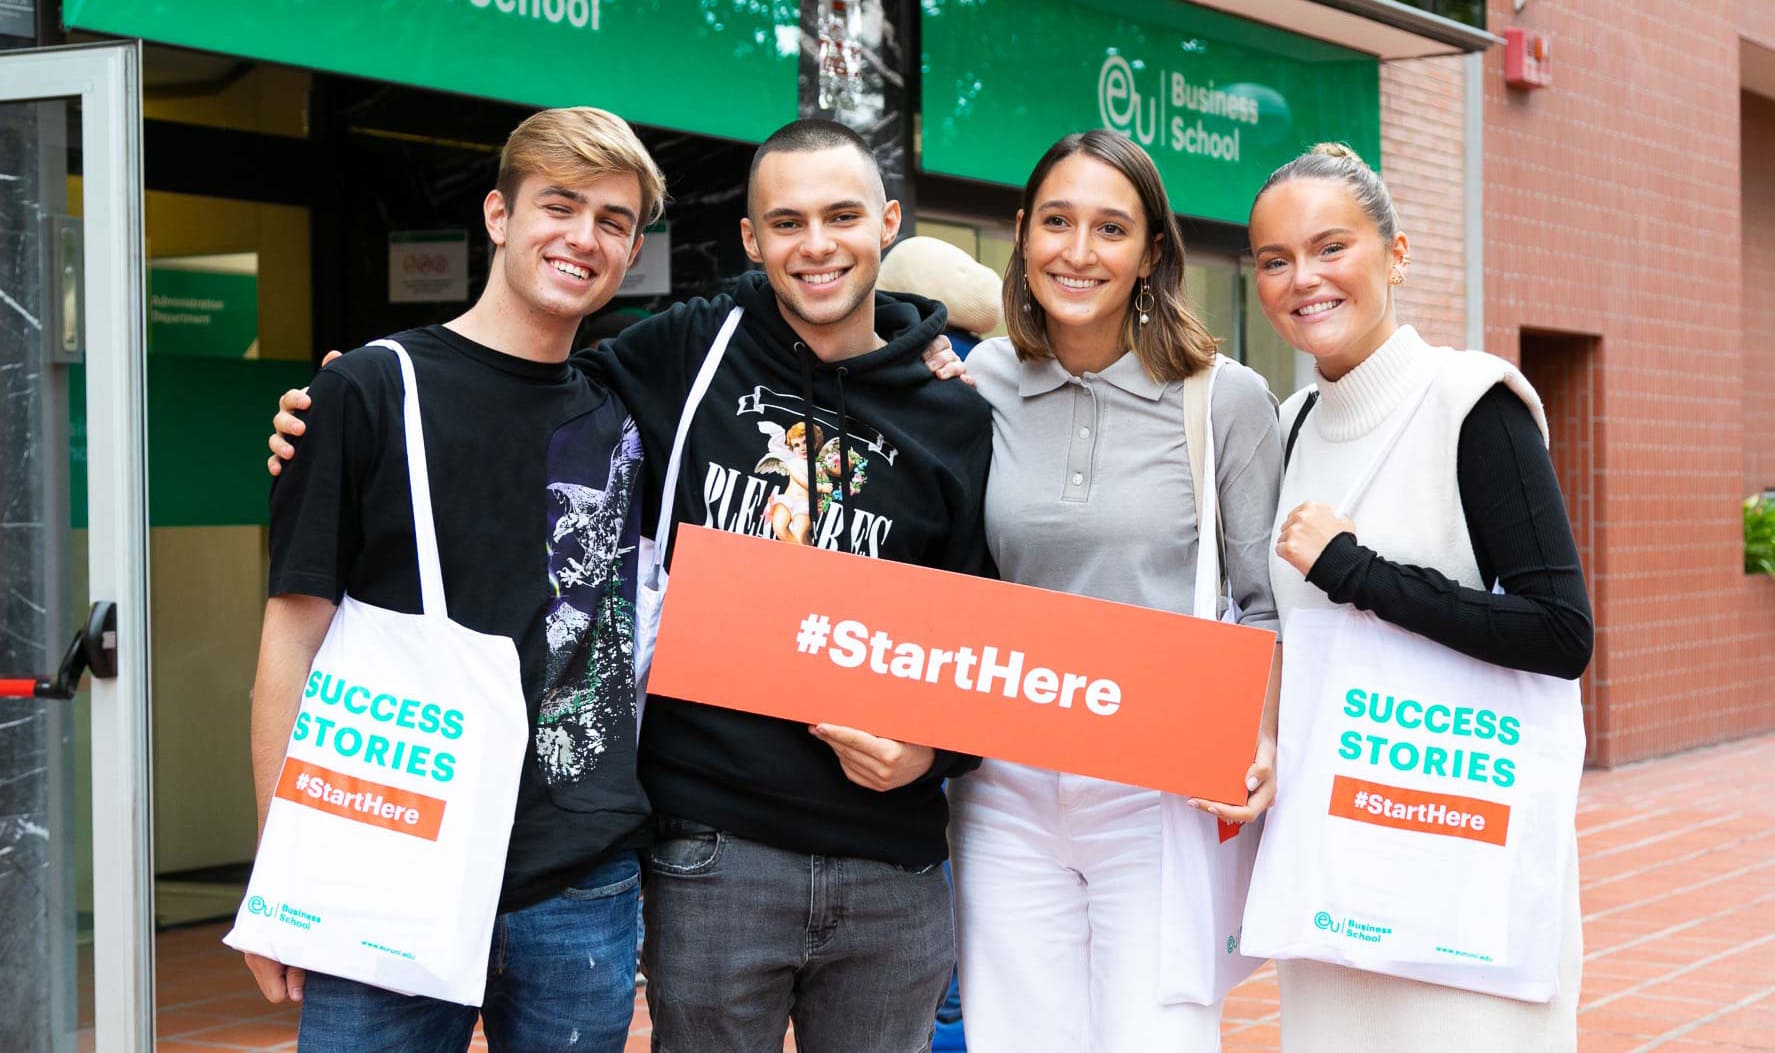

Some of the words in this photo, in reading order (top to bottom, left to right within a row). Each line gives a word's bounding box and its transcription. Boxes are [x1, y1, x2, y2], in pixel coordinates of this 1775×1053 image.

[1171, 71, 1259, 125] Business
[1171, 115, 1240, 162] School
[796, 613, 1122, 716] #StartHere
[305, 670, 465, 740] SUCCESS
[1343, 688, 1521, 746] SUCCESS
[293, 711, 457, 783] STORIES
[1338, 730, 1517, 788] STORIES
[295, 772, 420, 825] #StartHere
[1354, 790, 1486, 831] #StartHere
[279, 913, 311, 931] School
[281, 903, 321, 923] Business
[1346, 929, 1381, 943] School
[1348, 919, 1392, 935] Business
